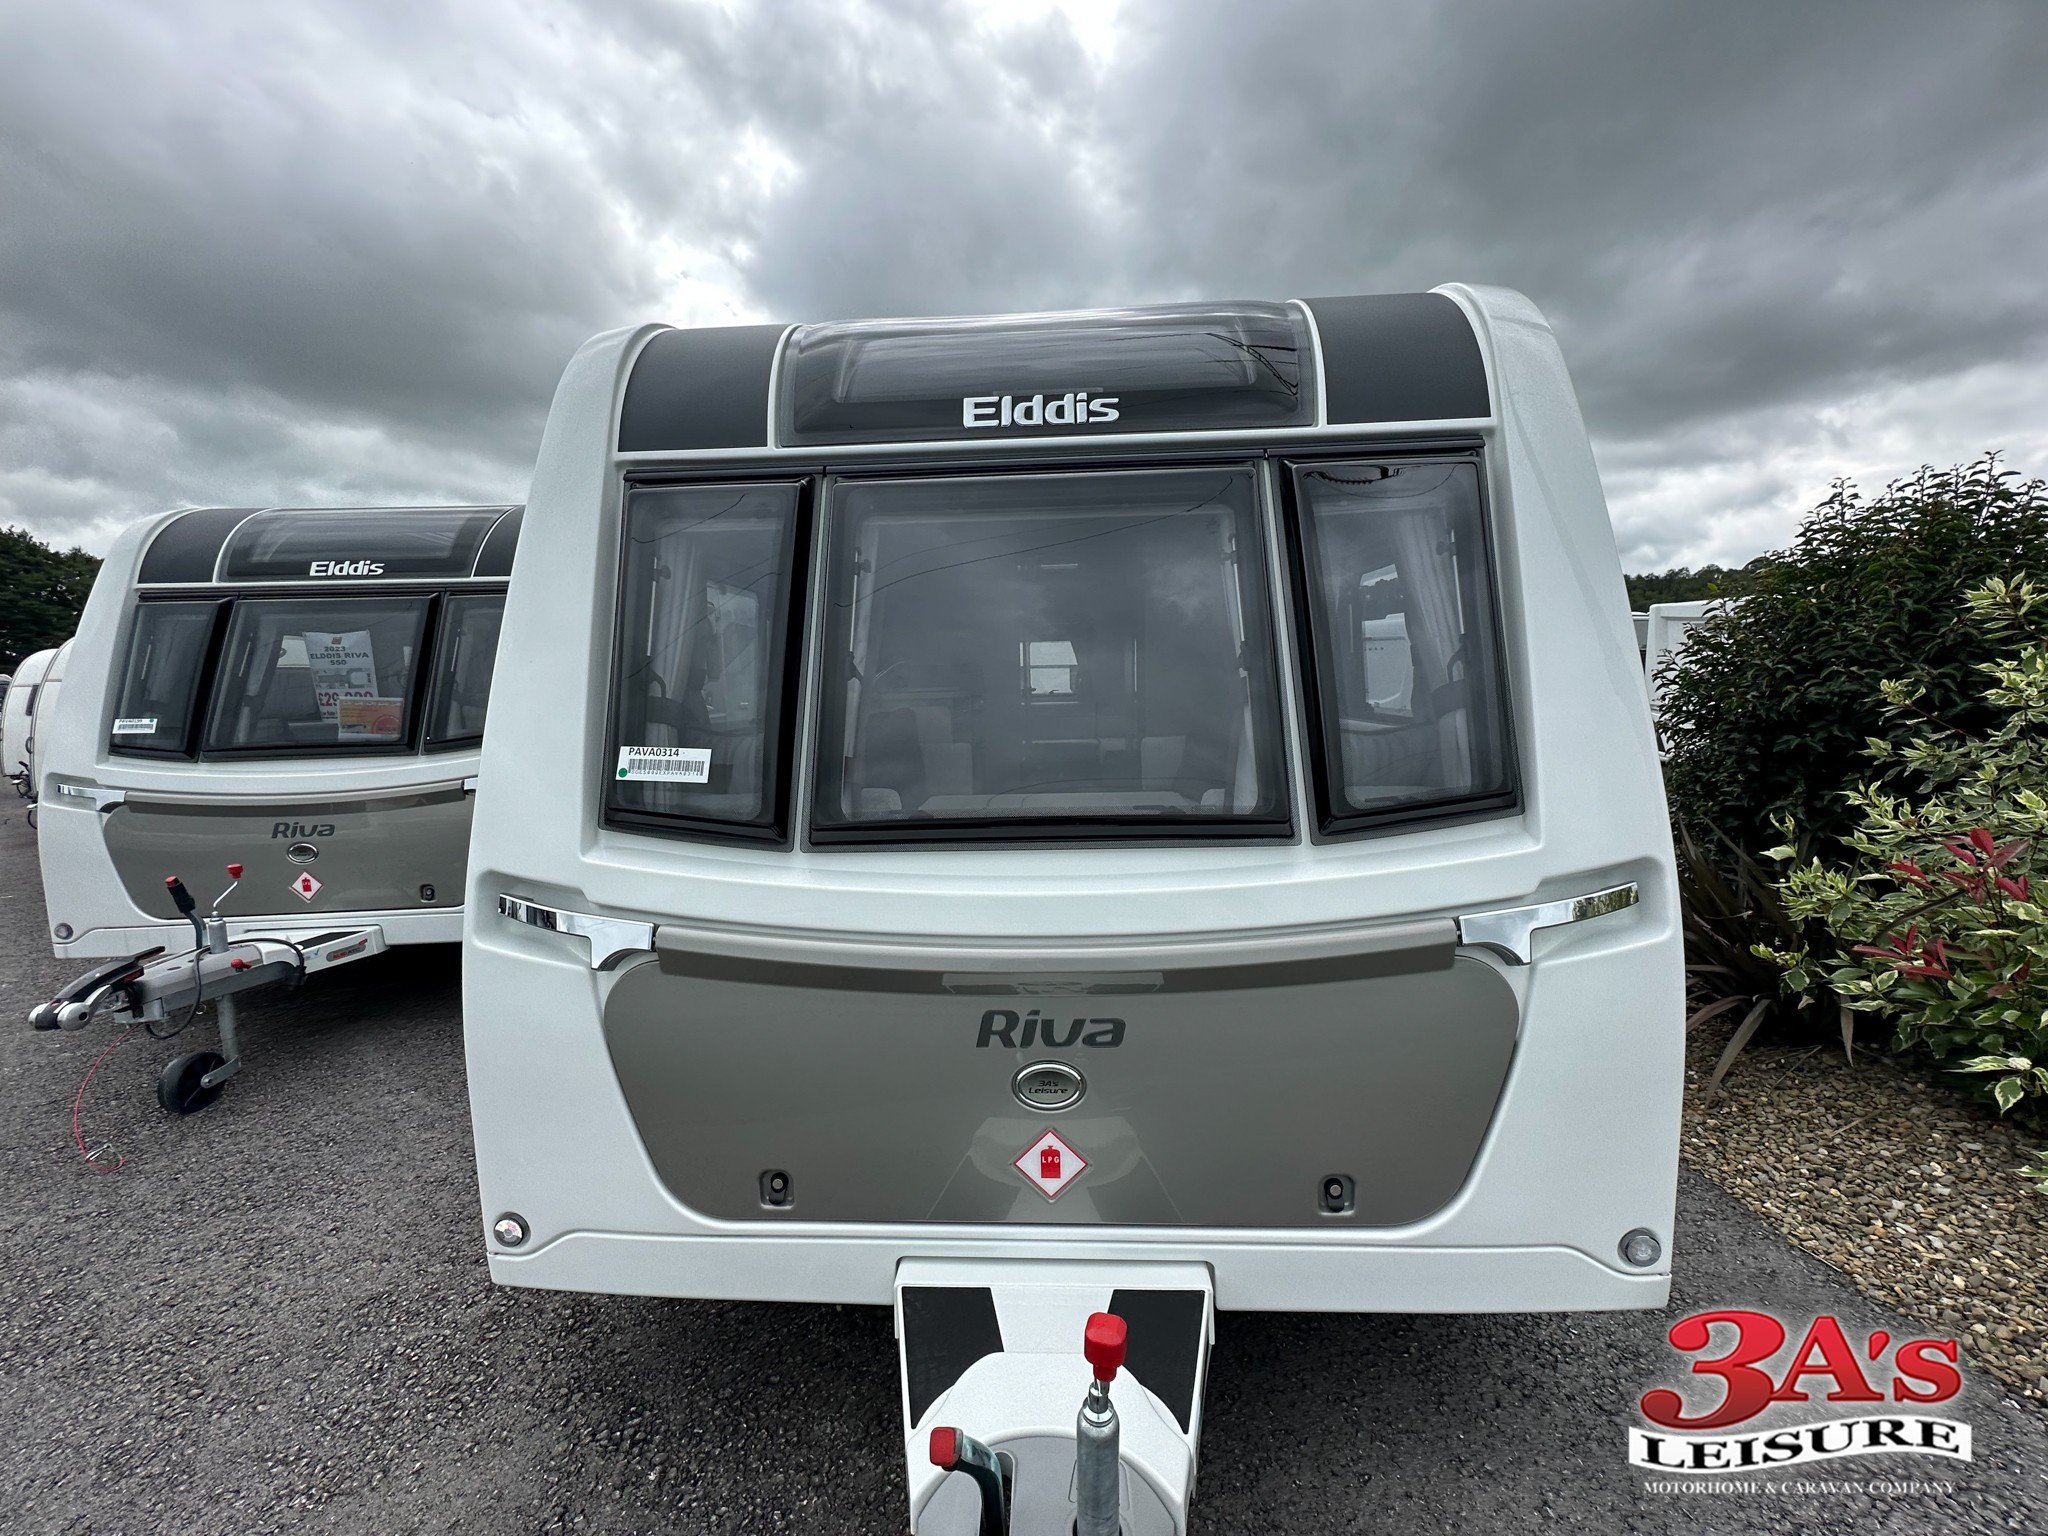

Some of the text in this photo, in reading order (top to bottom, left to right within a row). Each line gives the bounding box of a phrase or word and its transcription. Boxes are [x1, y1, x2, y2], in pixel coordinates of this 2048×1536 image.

[963, 393, 1120, 428] Elddis
[309, 560, 385, 577] Elddis
[628, 747, 680, 757] PAVA0314
[271, 822, 336, 839] Riva
[976, 1010, 1127, 1049] Riva
[1042, 1156, 1060, 1164] LPG
